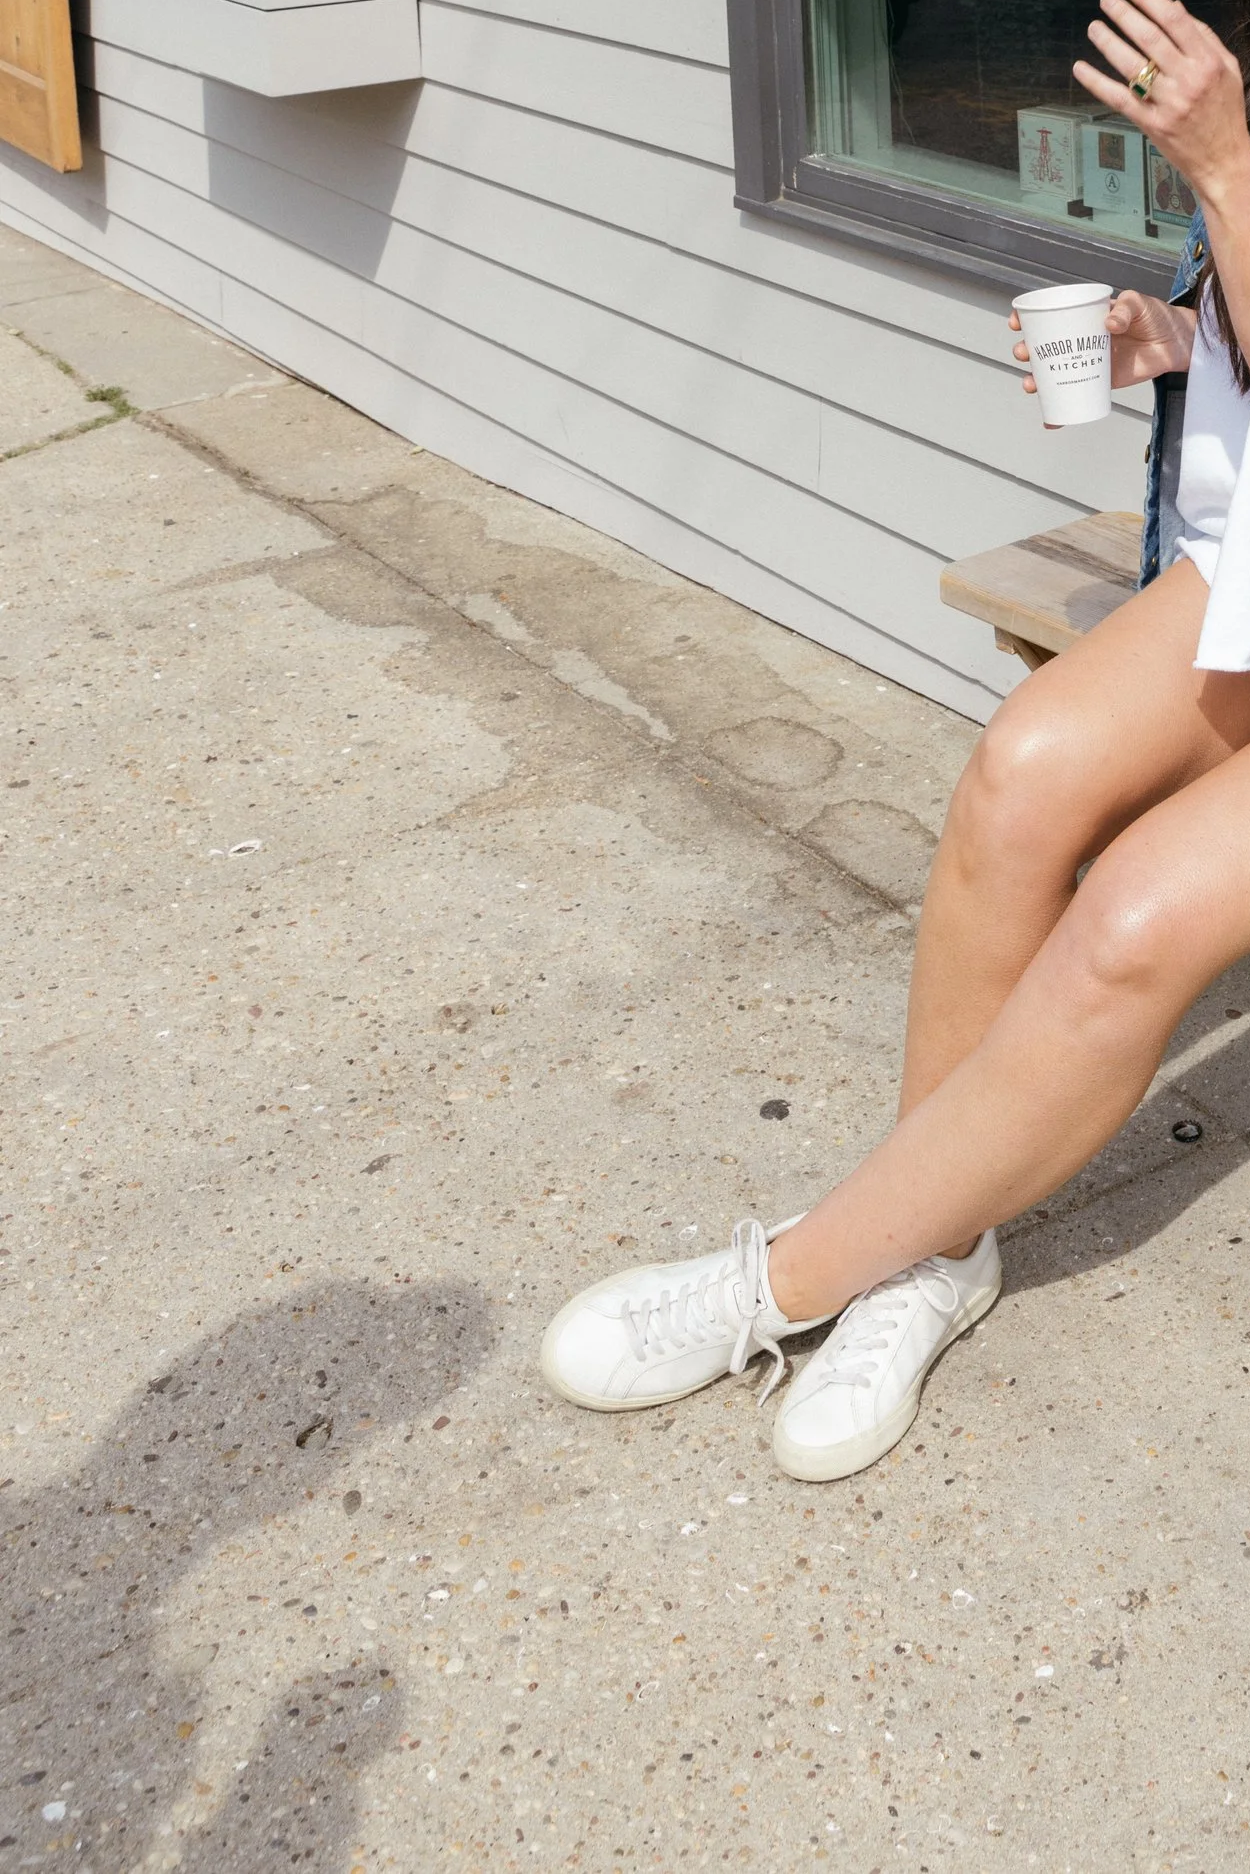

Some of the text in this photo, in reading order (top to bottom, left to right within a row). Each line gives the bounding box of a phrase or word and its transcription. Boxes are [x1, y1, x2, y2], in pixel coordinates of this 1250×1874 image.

[1034, 334, 1109, 361] HARBOR MARKET
[1049, 356, 1103, 371] KITCHEN
